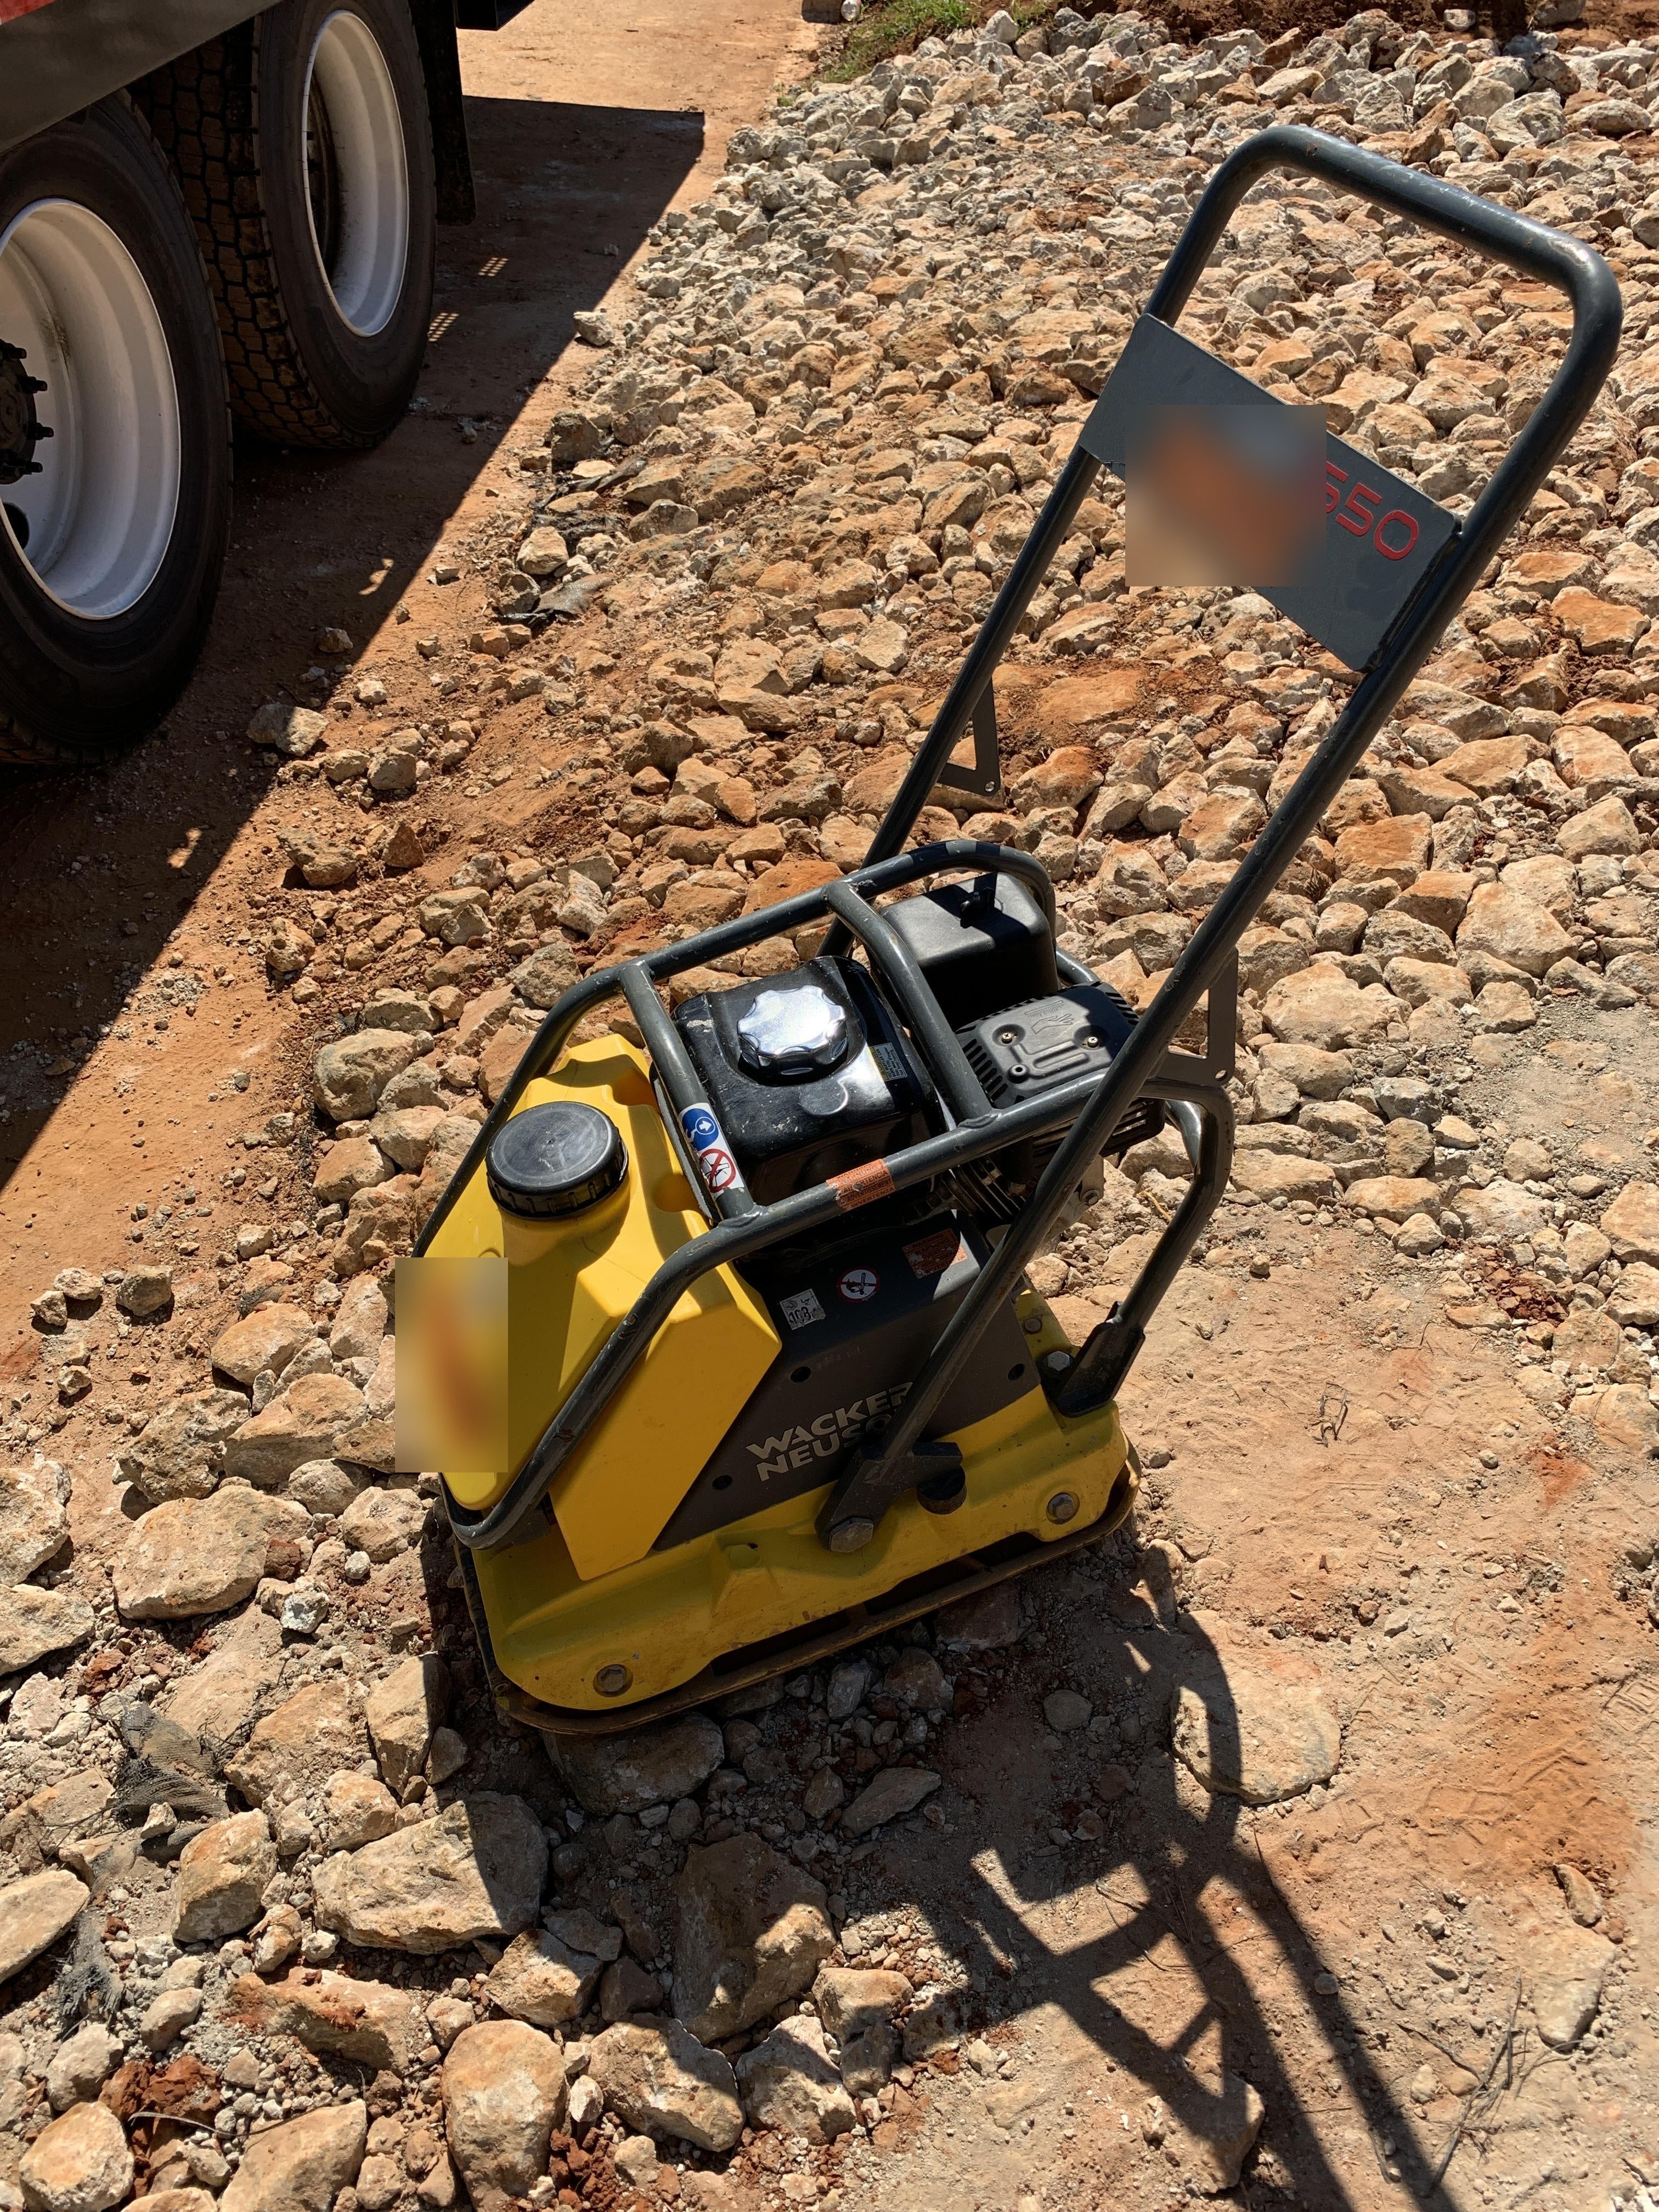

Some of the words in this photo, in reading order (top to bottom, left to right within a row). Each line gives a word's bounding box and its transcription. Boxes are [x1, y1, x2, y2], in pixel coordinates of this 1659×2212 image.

[844, 1170, 888, 1192] ADRTENCIA
[746, 1382, 913, 1460] WACKER
[757, 1409, 897, 1482] NEUSO
